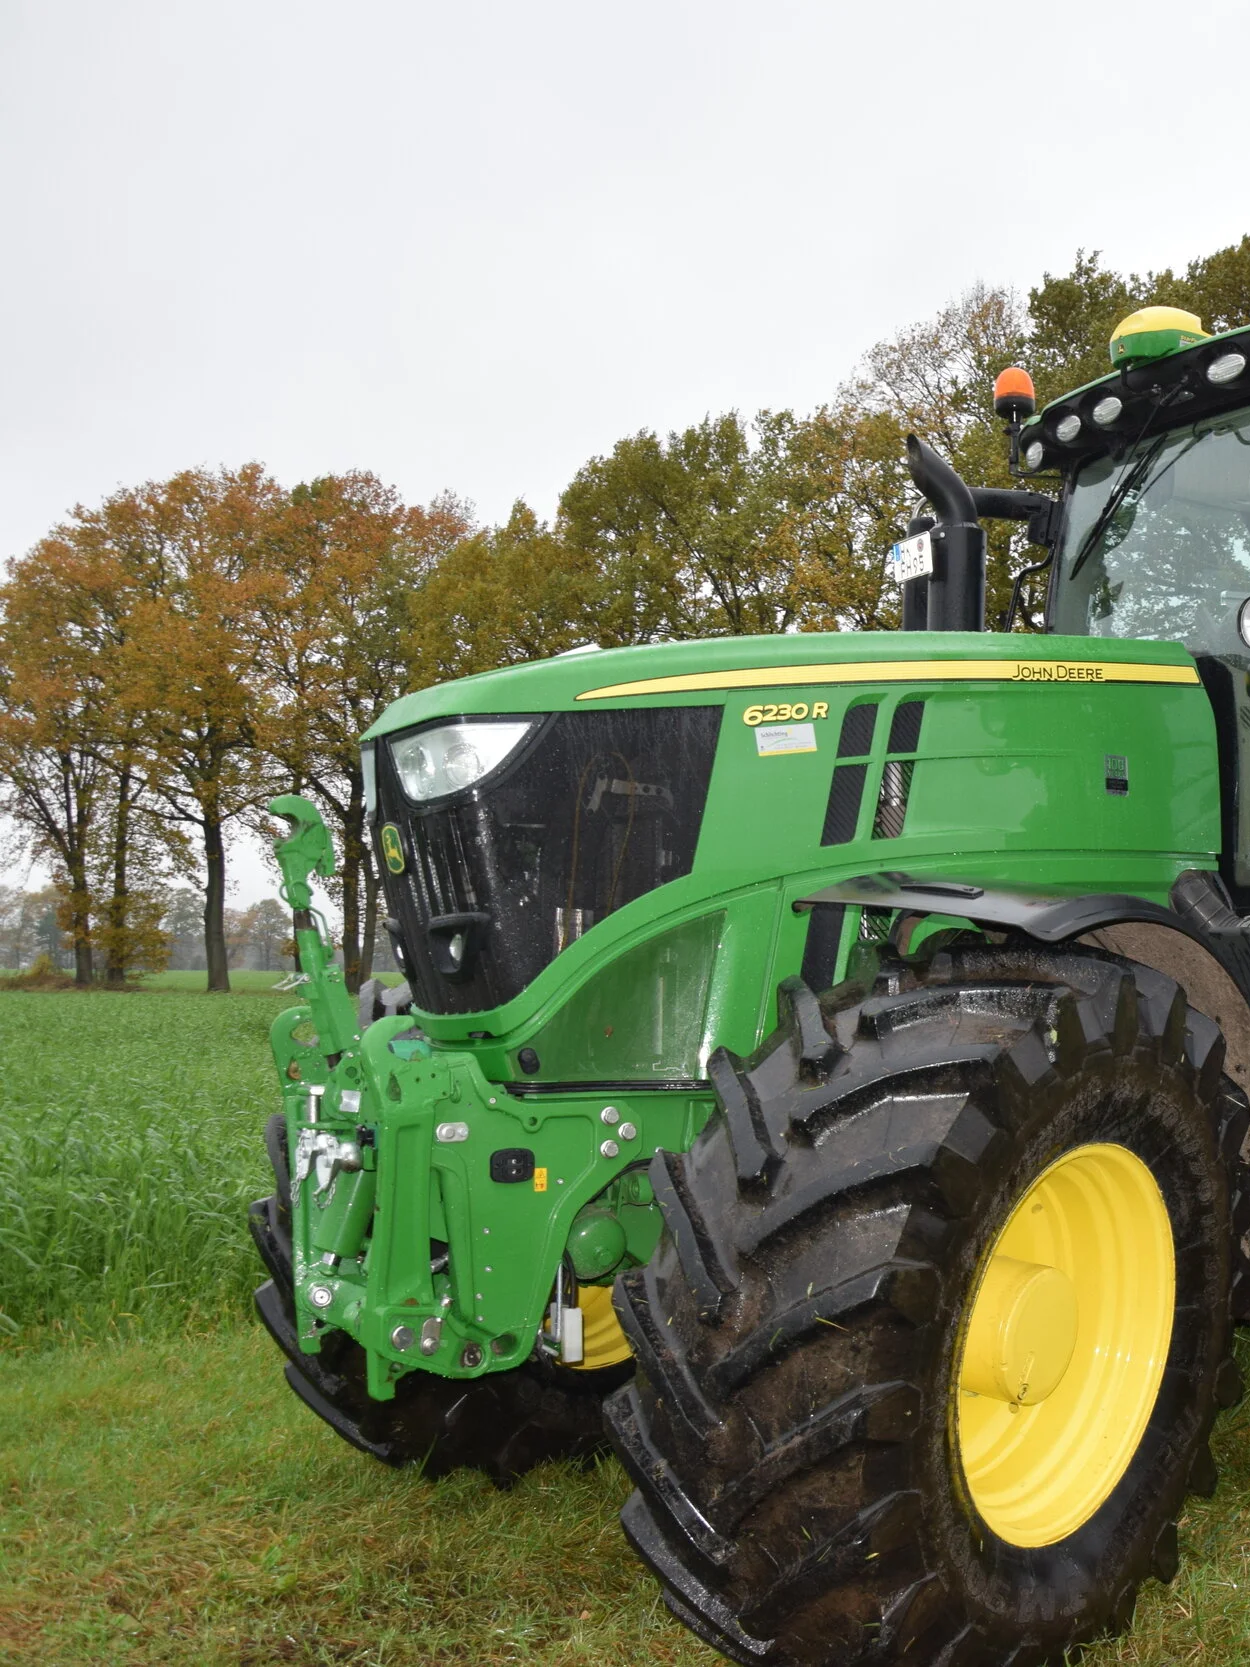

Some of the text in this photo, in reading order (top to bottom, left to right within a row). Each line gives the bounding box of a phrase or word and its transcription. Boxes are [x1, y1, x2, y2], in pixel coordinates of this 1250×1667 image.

[1012, 664, 1104, 680] JOHN DEERE
[743, 701, 830, 727] 6230 R
